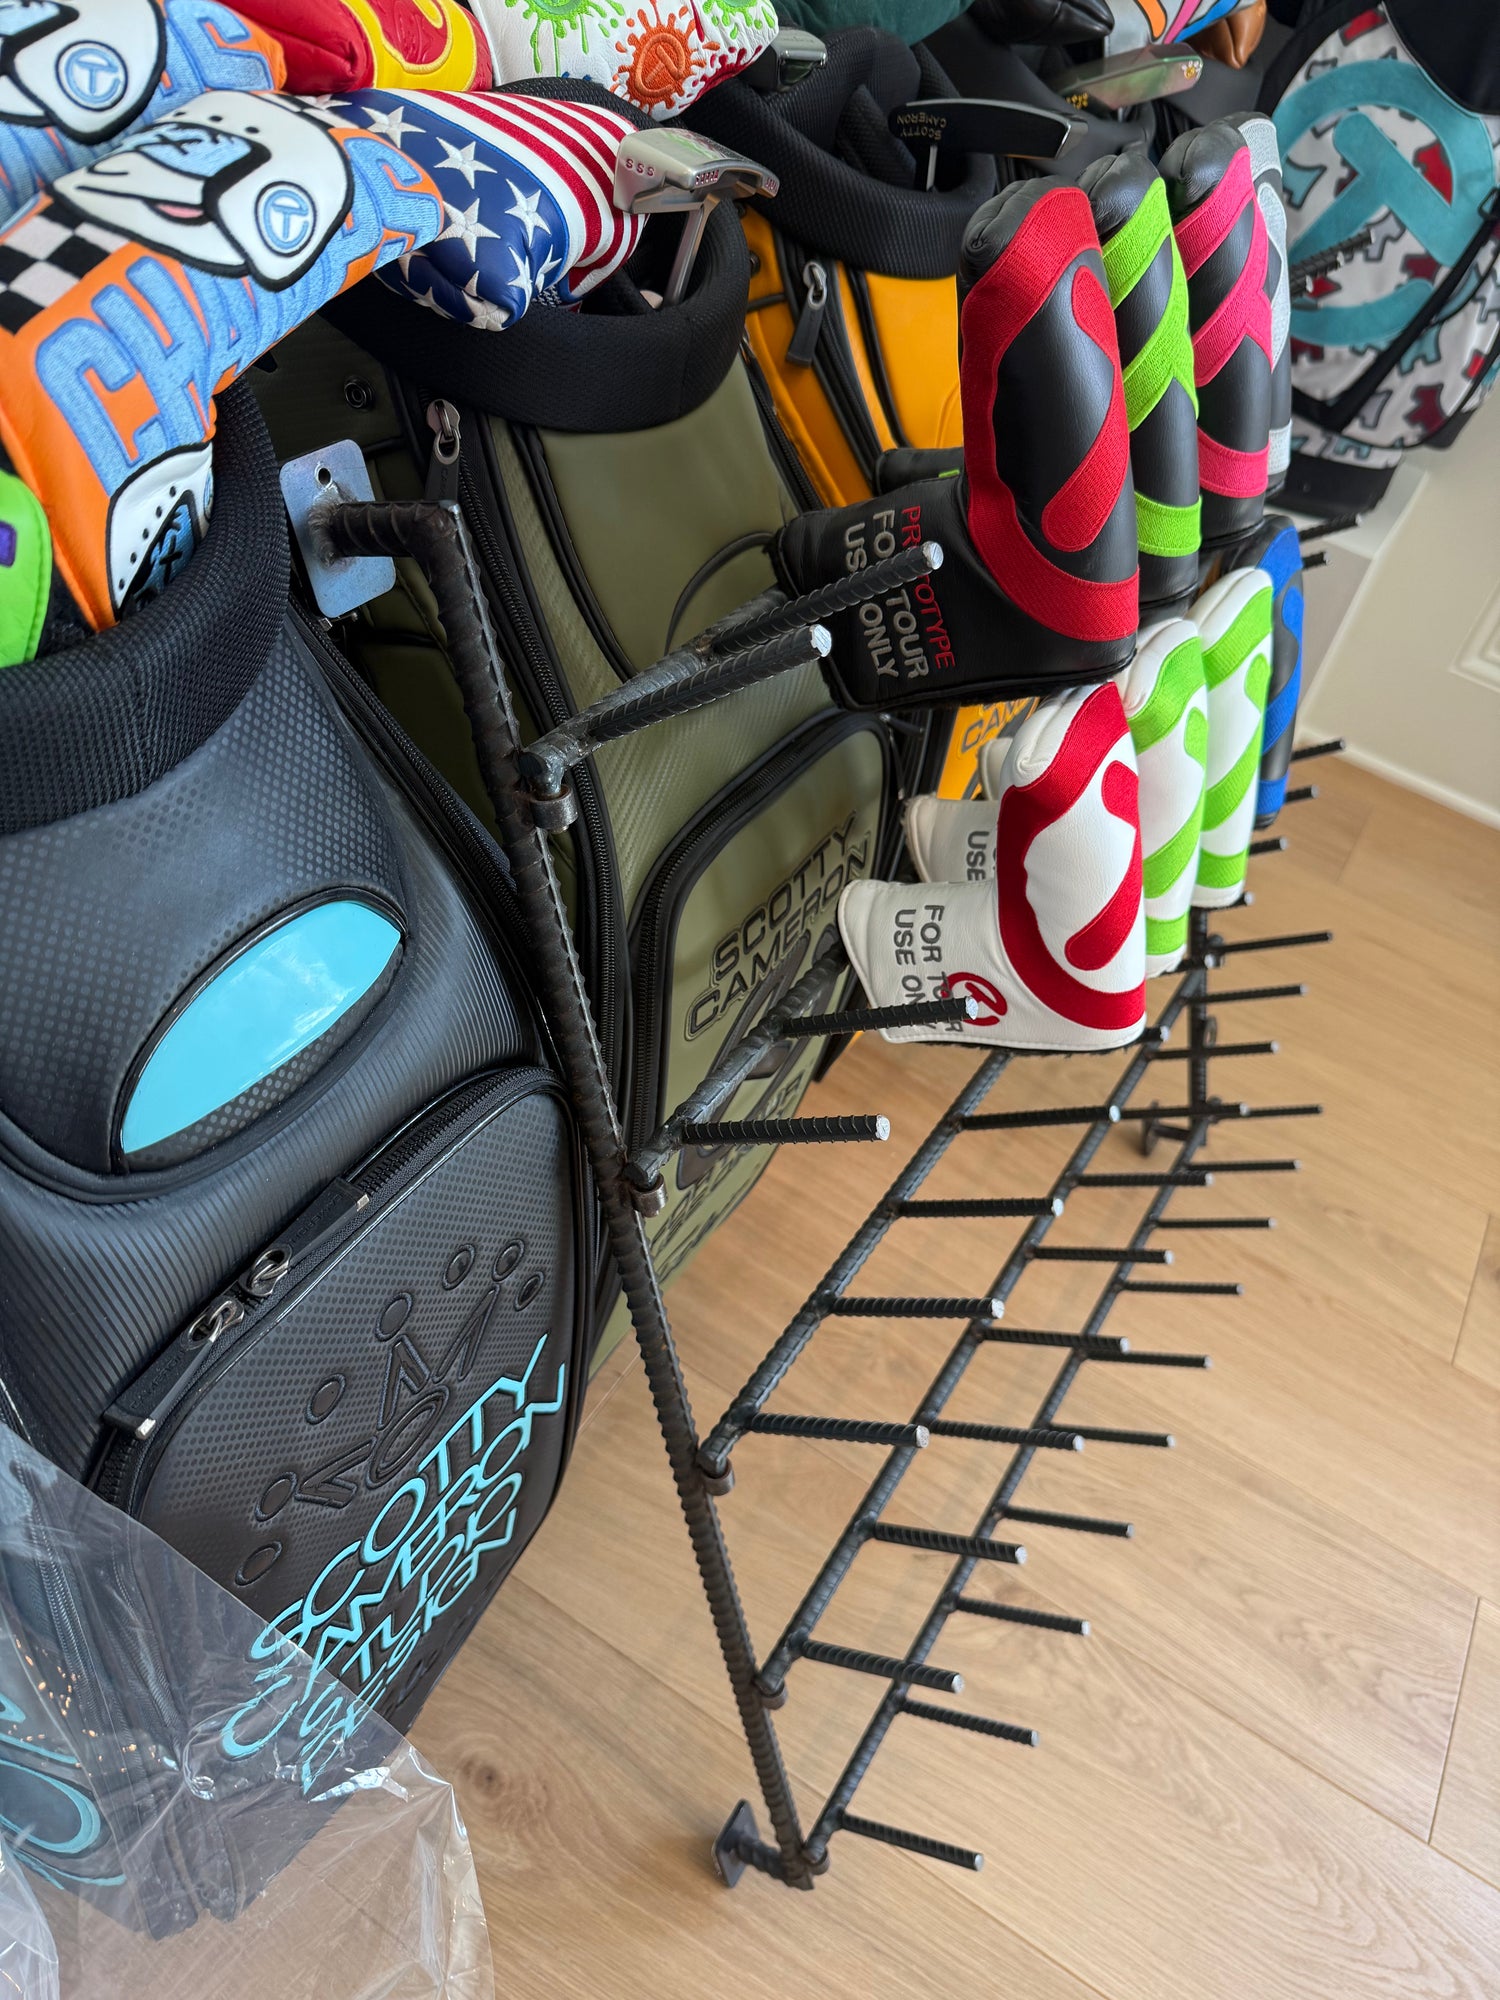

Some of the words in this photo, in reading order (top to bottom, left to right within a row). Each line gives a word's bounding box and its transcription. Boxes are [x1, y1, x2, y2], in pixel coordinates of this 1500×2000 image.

[896, 112, 947, 130] CAMERON
[900, 126, 942, 141] SCOTTY
[845, 522, 868, 573] US
[859, 602, 900, 678] ONLY
[873, 509, 896, 559] FO
[886, 588, 930, 679] TOUR
[902, 505, 956, 669] PROTYPE
[687, 833, 869, 1036] CAMERON
[712, 811, 857, 983] SCOTTY
[893, 908, 917, 966] USE
[920, 904, 945, 963] FOR
[927, 971, 963, 1032] TOR
[221, 1363, 564, 1756] CAMERON
[250, 1333, 548, 1682] SCOTTY
[300, 1472, 523, 1738] STUDIO
